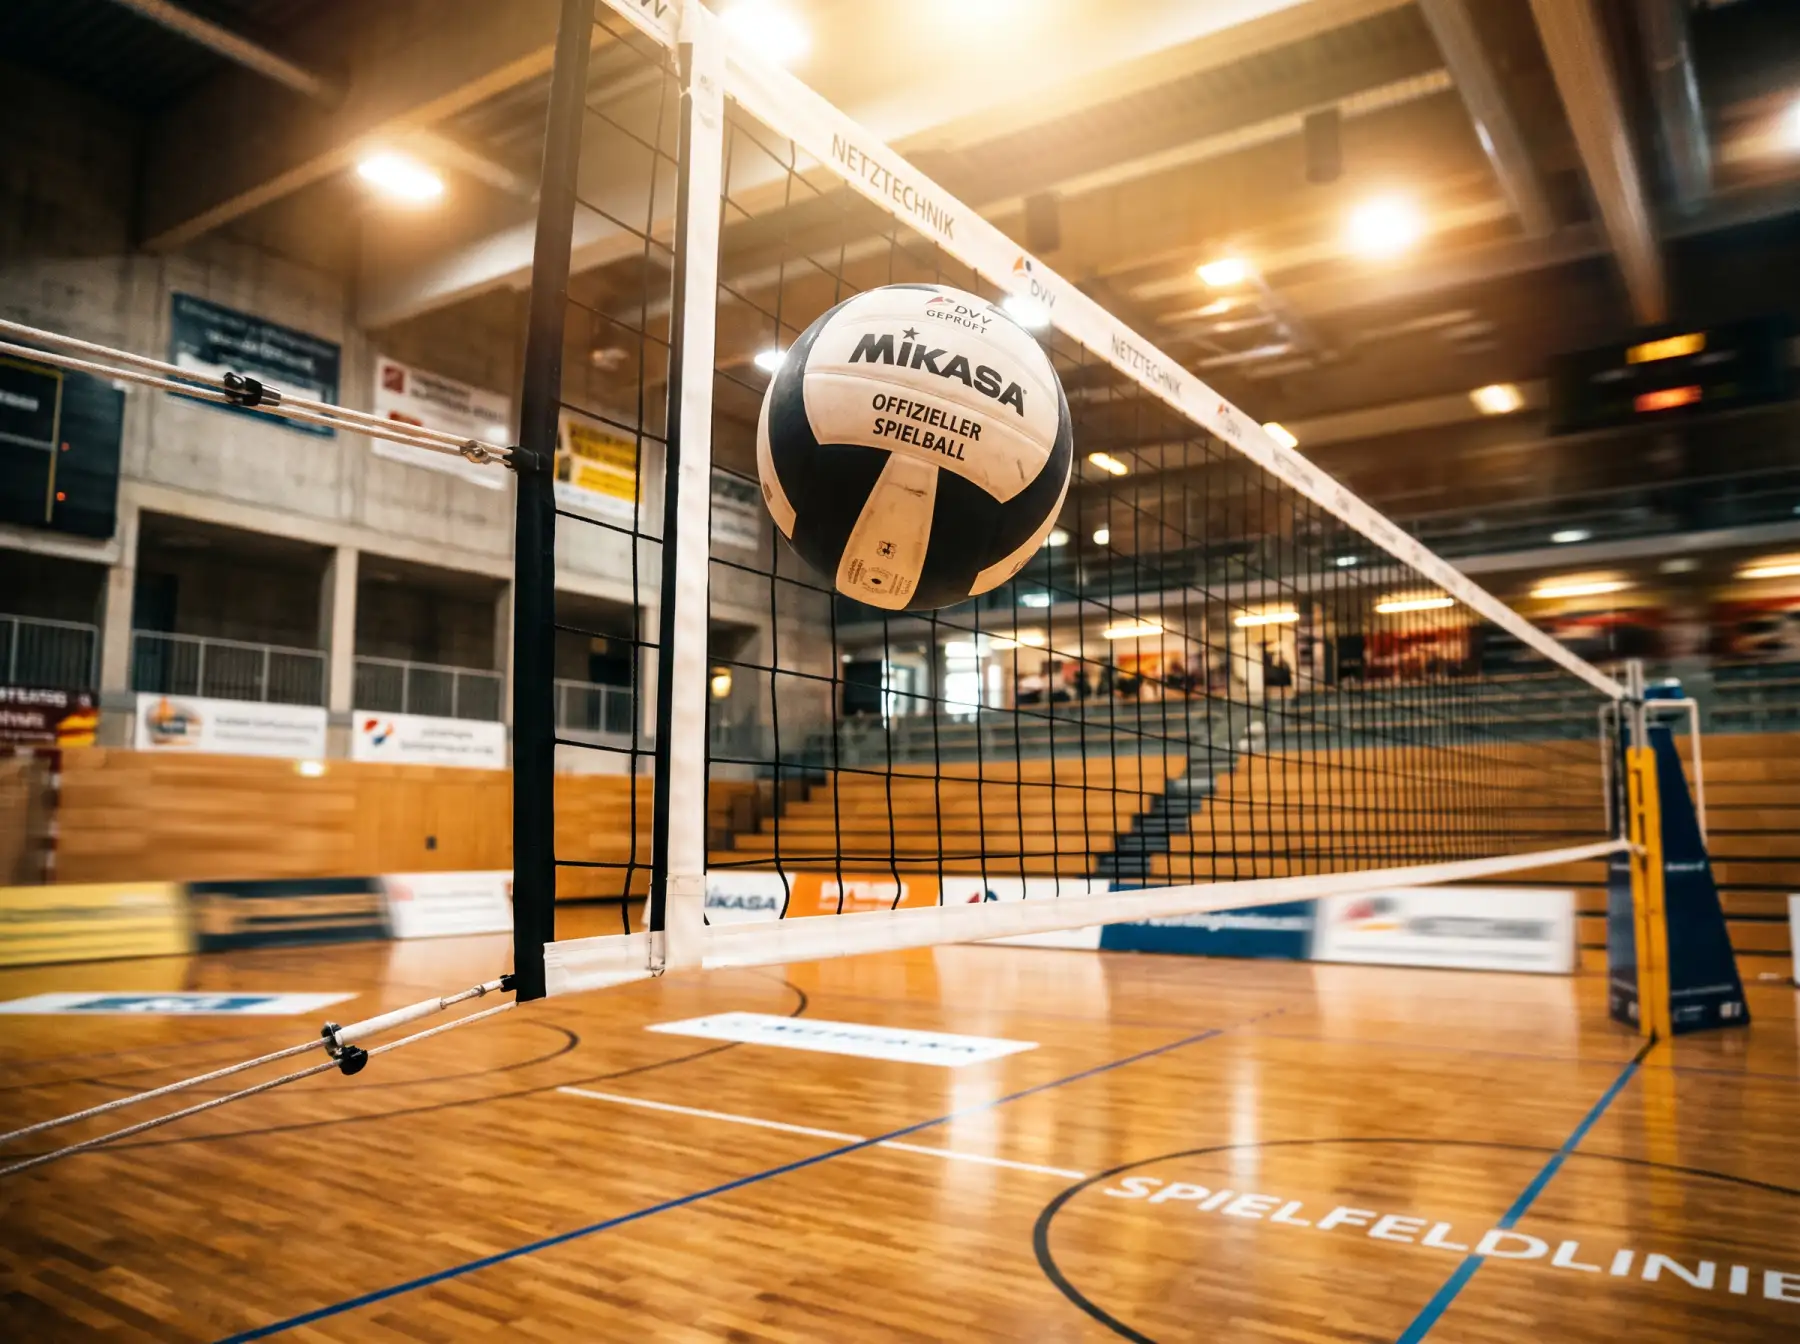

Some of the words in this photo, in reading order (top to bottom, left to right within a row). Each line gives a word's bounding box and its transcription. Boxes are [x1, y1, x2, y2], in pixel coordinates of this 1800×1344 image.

[832, 133, 954, 240] NETZTECHNIK
[954, 305, 993, 324] DVV
[1030, 279, 1056, 308] DVV
[1111, 334, 1183, 398] NETZTECHNIK
[872, 393, 982, 441] OFFIZIELLER
[872, 418, 965, 461] SPIELBALL
[1103, 1176, 1800, 1304] SPIELFELDLINIE
